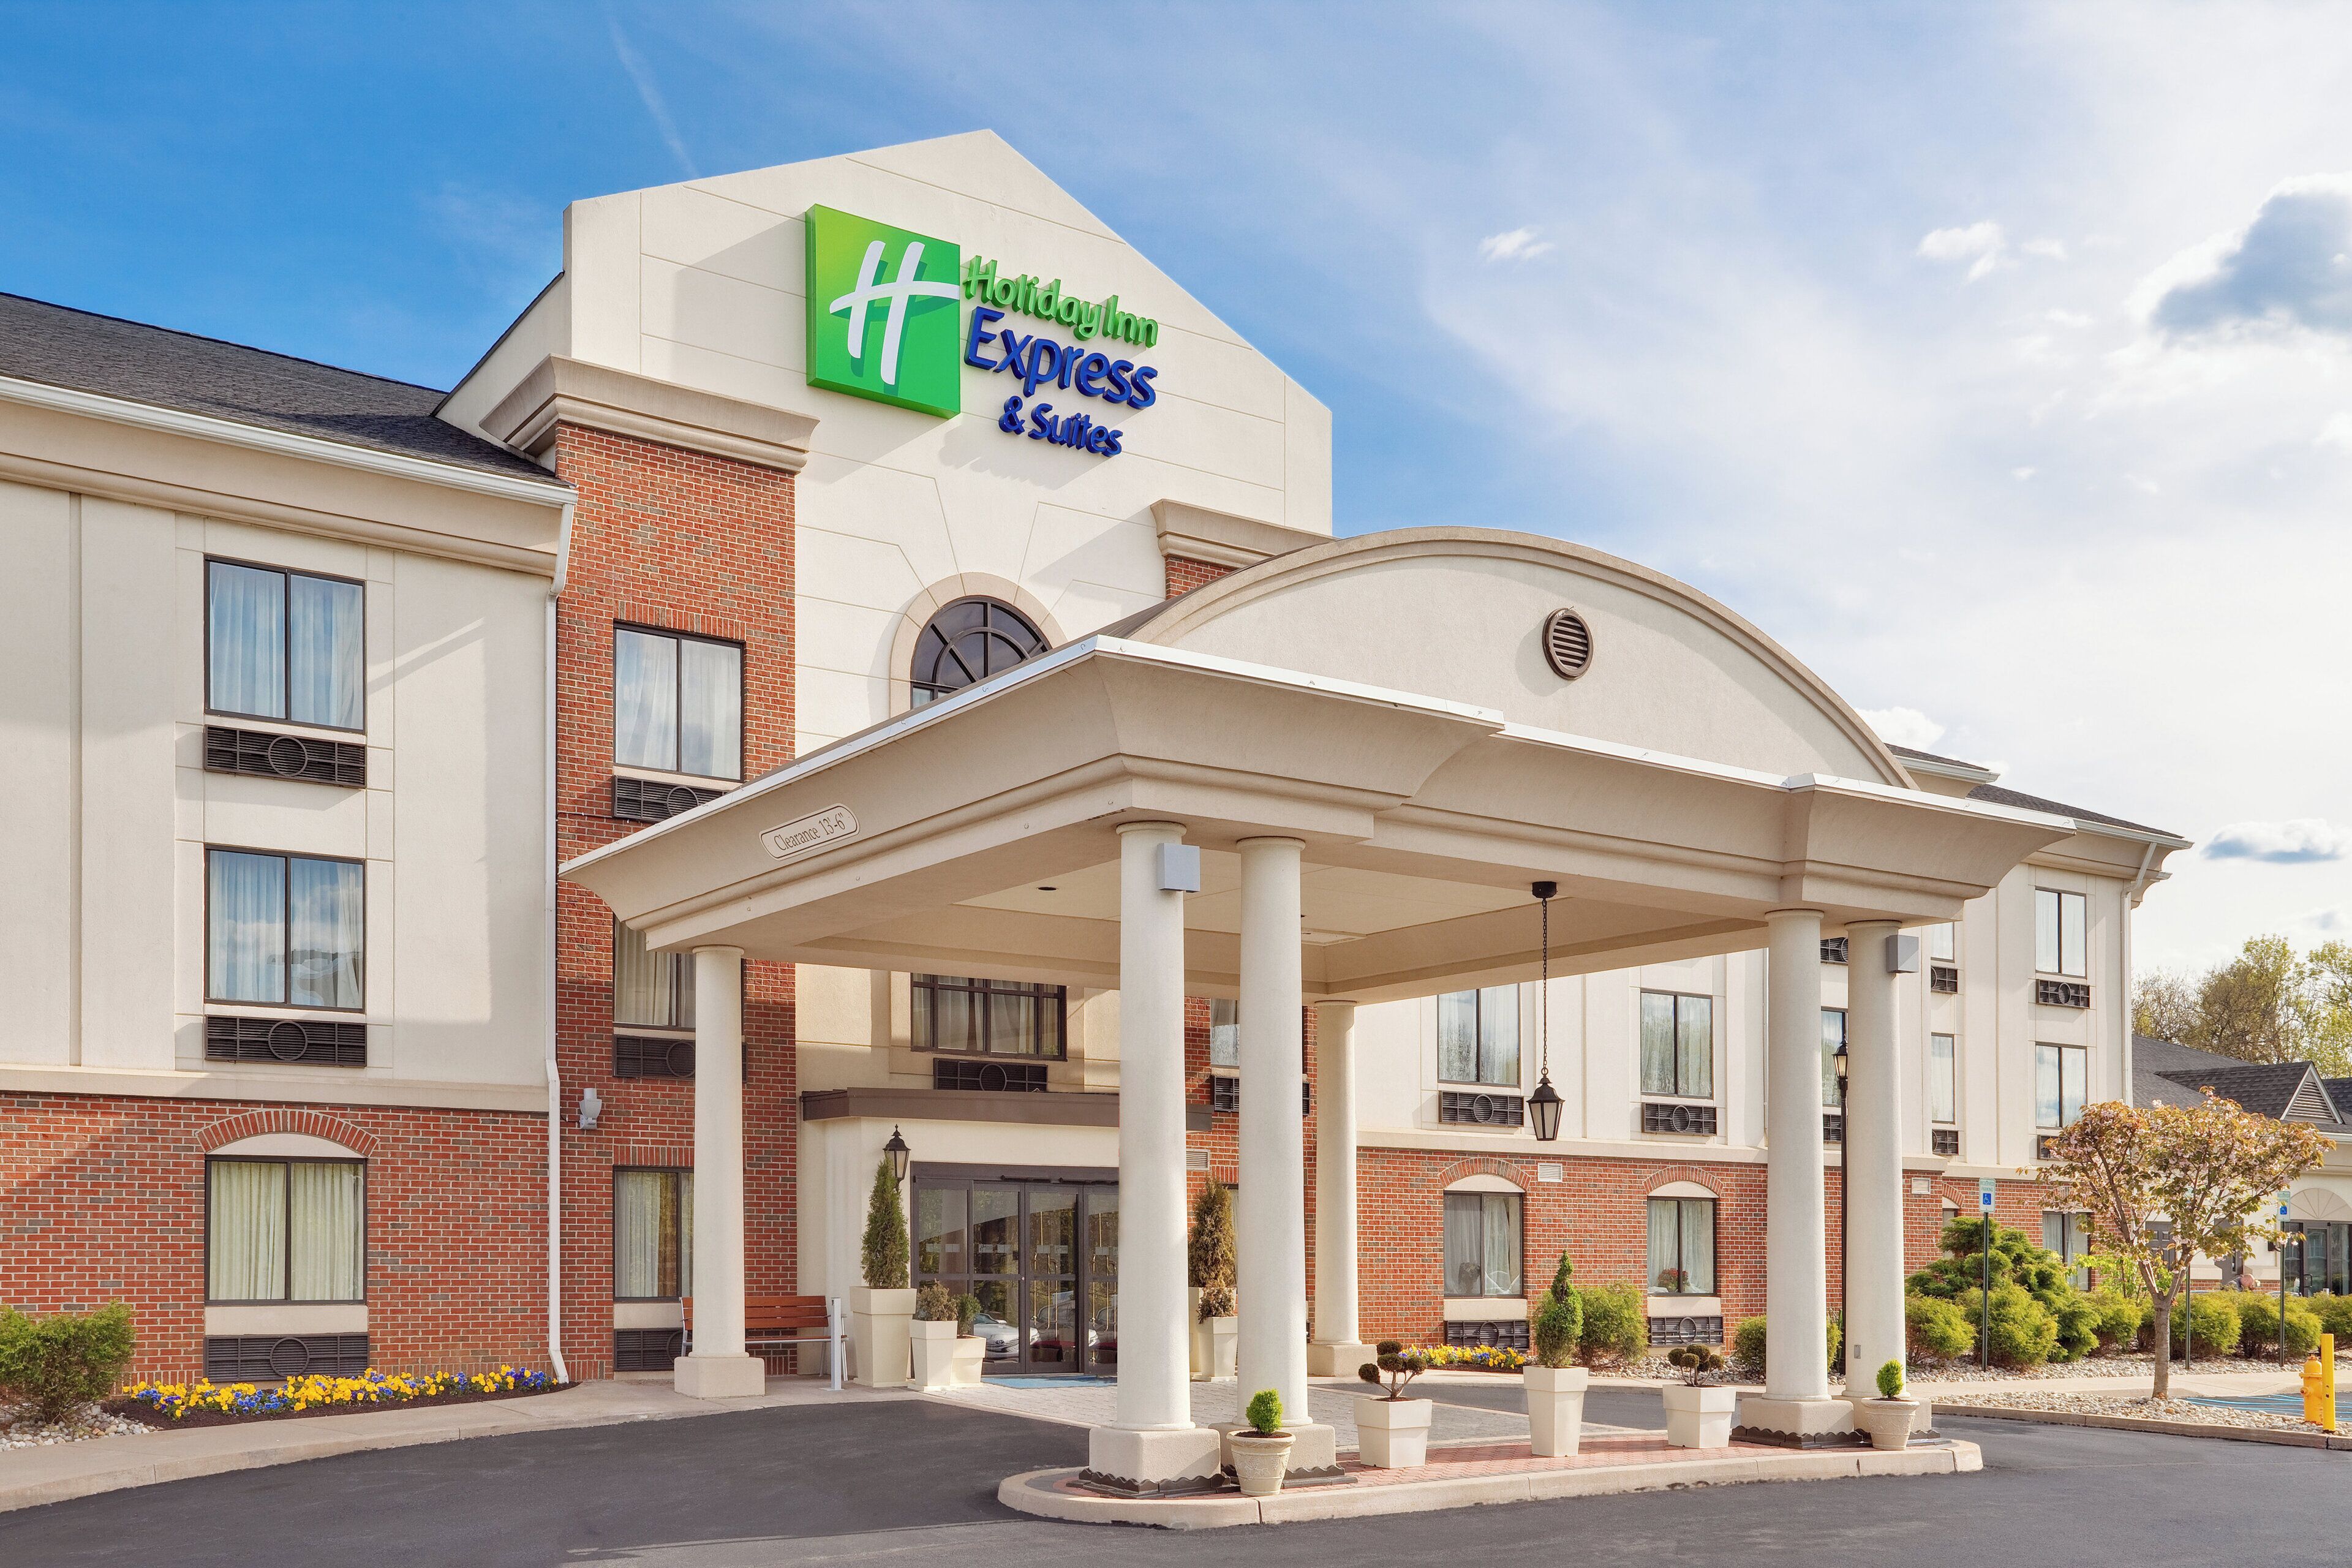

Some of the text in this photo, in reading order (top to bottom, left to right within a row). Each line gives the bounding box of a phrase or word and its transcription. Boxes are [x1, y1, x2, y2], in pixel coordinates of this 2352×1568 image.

[962, 255, 1158, 348] Holiday Inn
[965, 306, 1158, 409] Express
[998, 395, 1123, 458] & Suites
[774, 812, 845, 851] Clearance 13'-6"
